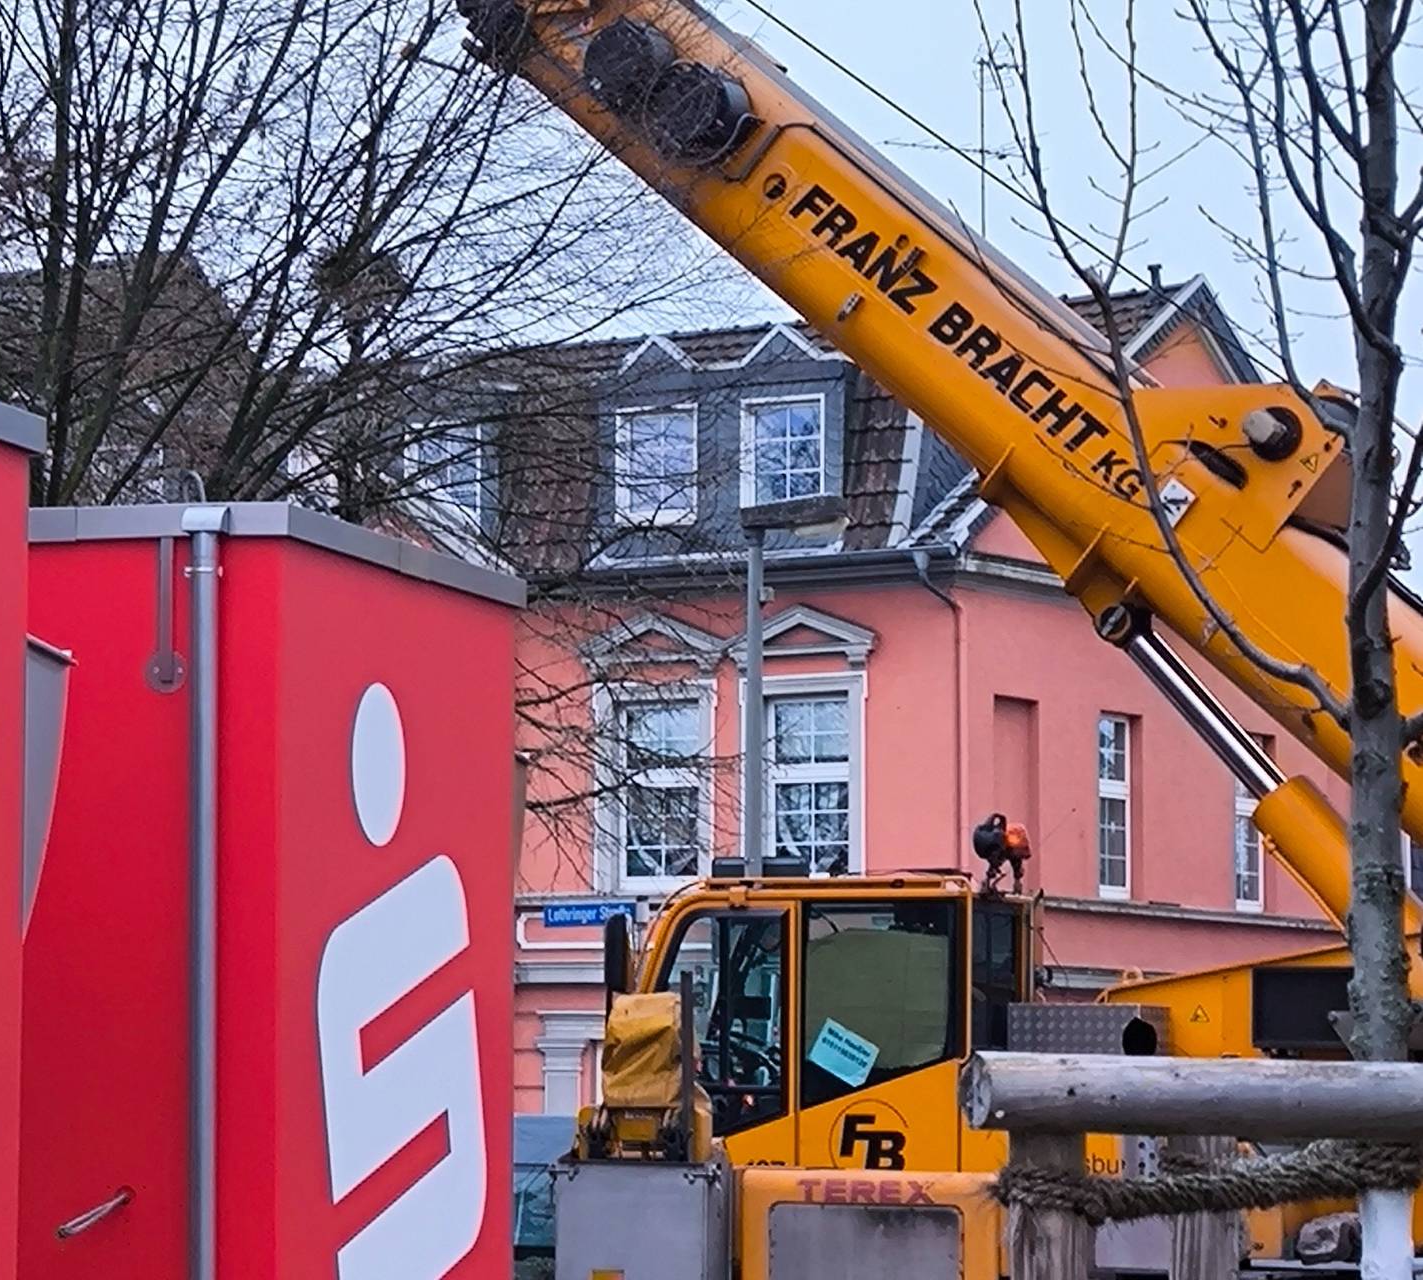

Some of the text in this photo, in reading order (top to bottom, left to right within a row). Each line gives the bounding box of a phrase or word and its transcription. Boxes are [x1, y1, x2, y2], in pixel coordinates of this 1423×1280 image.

[789, 184, 1146, 501] FRANZ BRACHT KG
[548, 907, 597, 924] Lothringer
[839, 1114, 906, 1170] FB
[797, 1178, 937, 1204] TEREX
